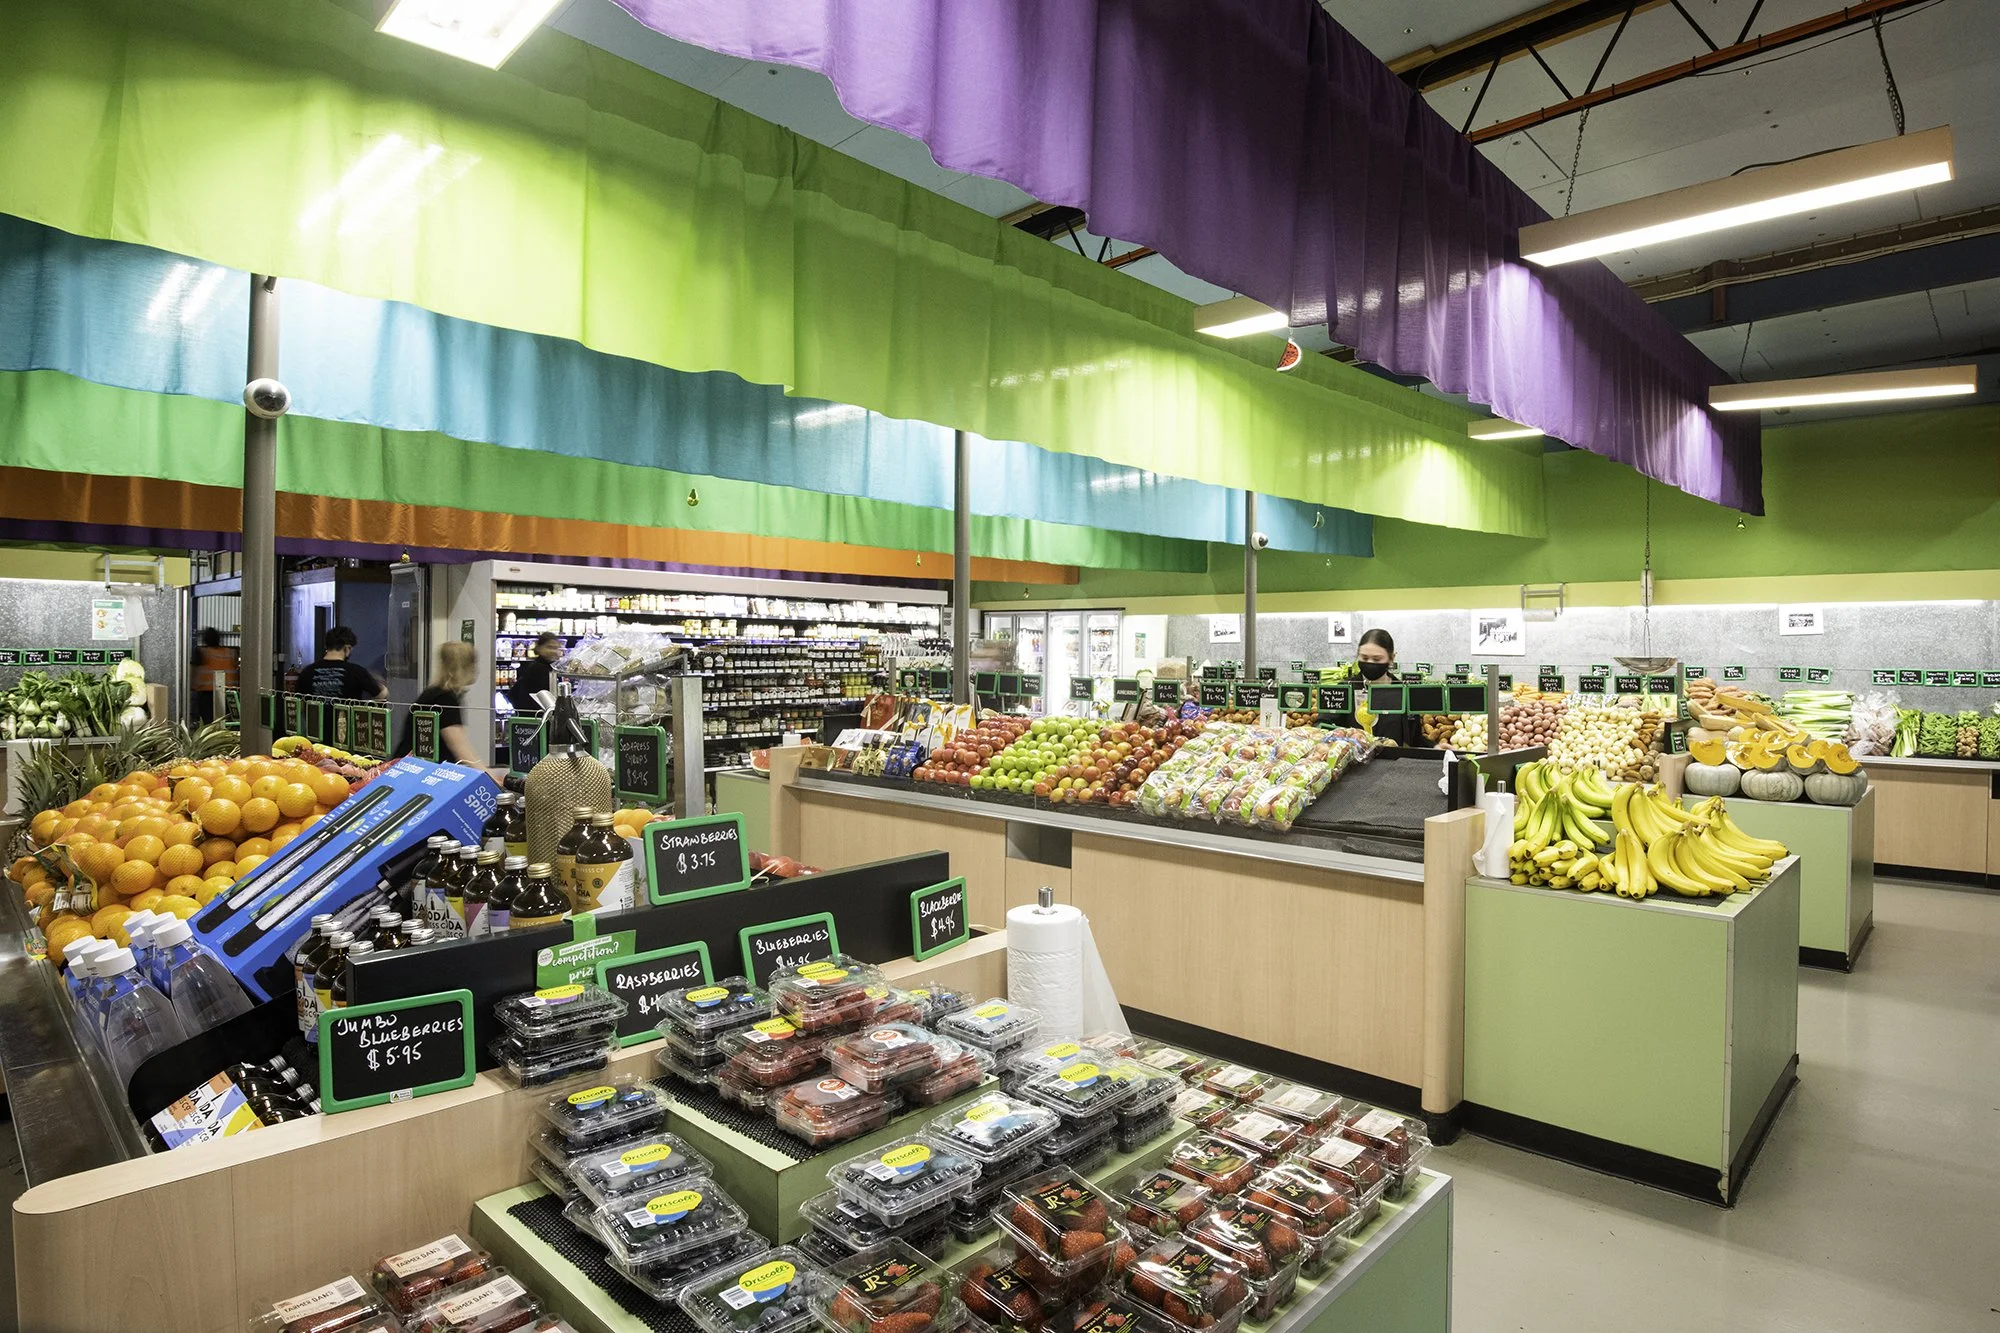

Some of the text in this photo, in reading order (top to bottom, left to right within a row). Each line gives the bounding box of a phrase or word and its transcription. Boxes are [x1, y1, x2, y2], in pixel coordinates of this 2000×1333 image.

[660, 828, 738, 851] STRAWBERRIES
[676, 851, 717, 875] $3.75
[551, 941, 620, 967] competition?
[755, 929, 830, 956] BLUEBERRIES
[615, 961, 701, 990] RASPBERRIES
[337, 1014, 397, 1036] JUMBO
[359, 1017, 464, 1048] BLUEBERRIES
[648, 1193, 699, 1211] Driscoll's
[741, 1263, 791, 1288] Driscoll's
[862, 1275, 888, 1292] JR
